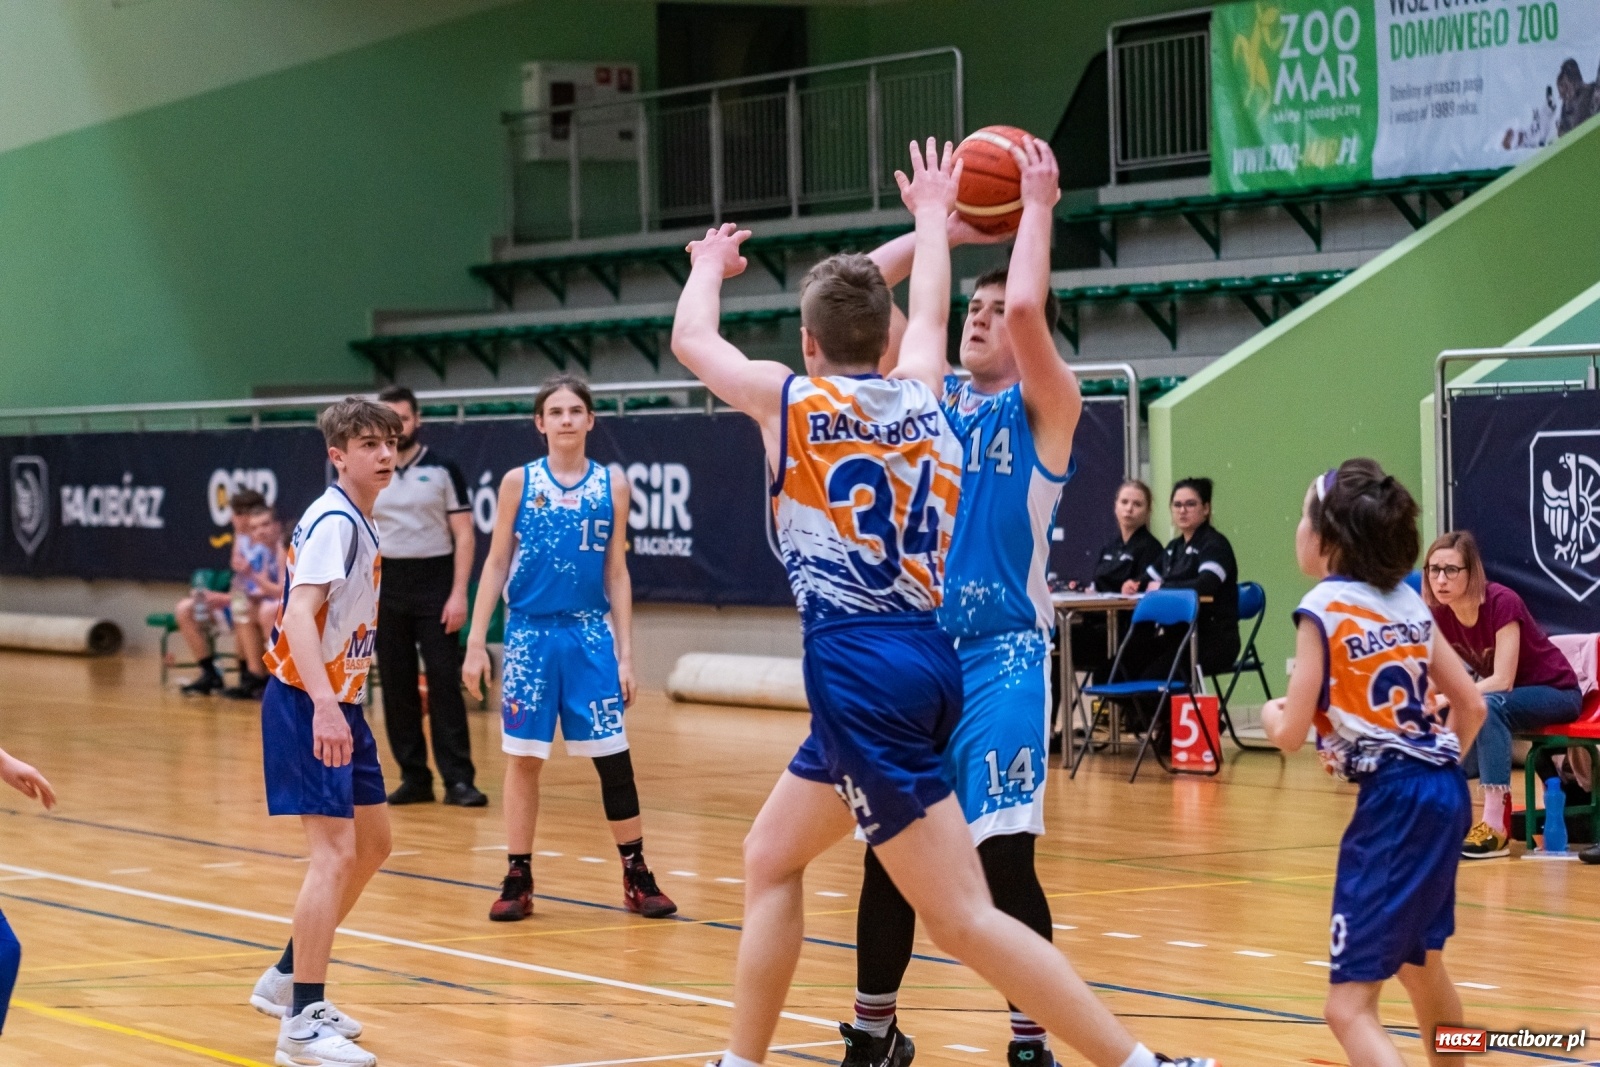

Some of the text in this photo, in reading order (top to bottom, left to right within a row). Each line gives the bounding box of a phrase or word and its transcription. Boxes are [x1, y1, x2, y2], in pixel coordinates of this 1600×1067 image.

[1280, 6, 1361, 60] ZOO
[1389, 2, 1559, 61] DOMOWEGO ZOO
[1273, 55, 1361, 105] MAR
[966, 426, 1013, 475] 14
[578, 518, 610, 552] 15
[827, 455, 943, 590] 34
[588, 697, 622, 732] 15
[1172, 702, 1201, 749] 5
[985, 747, 1036, 795] 14
